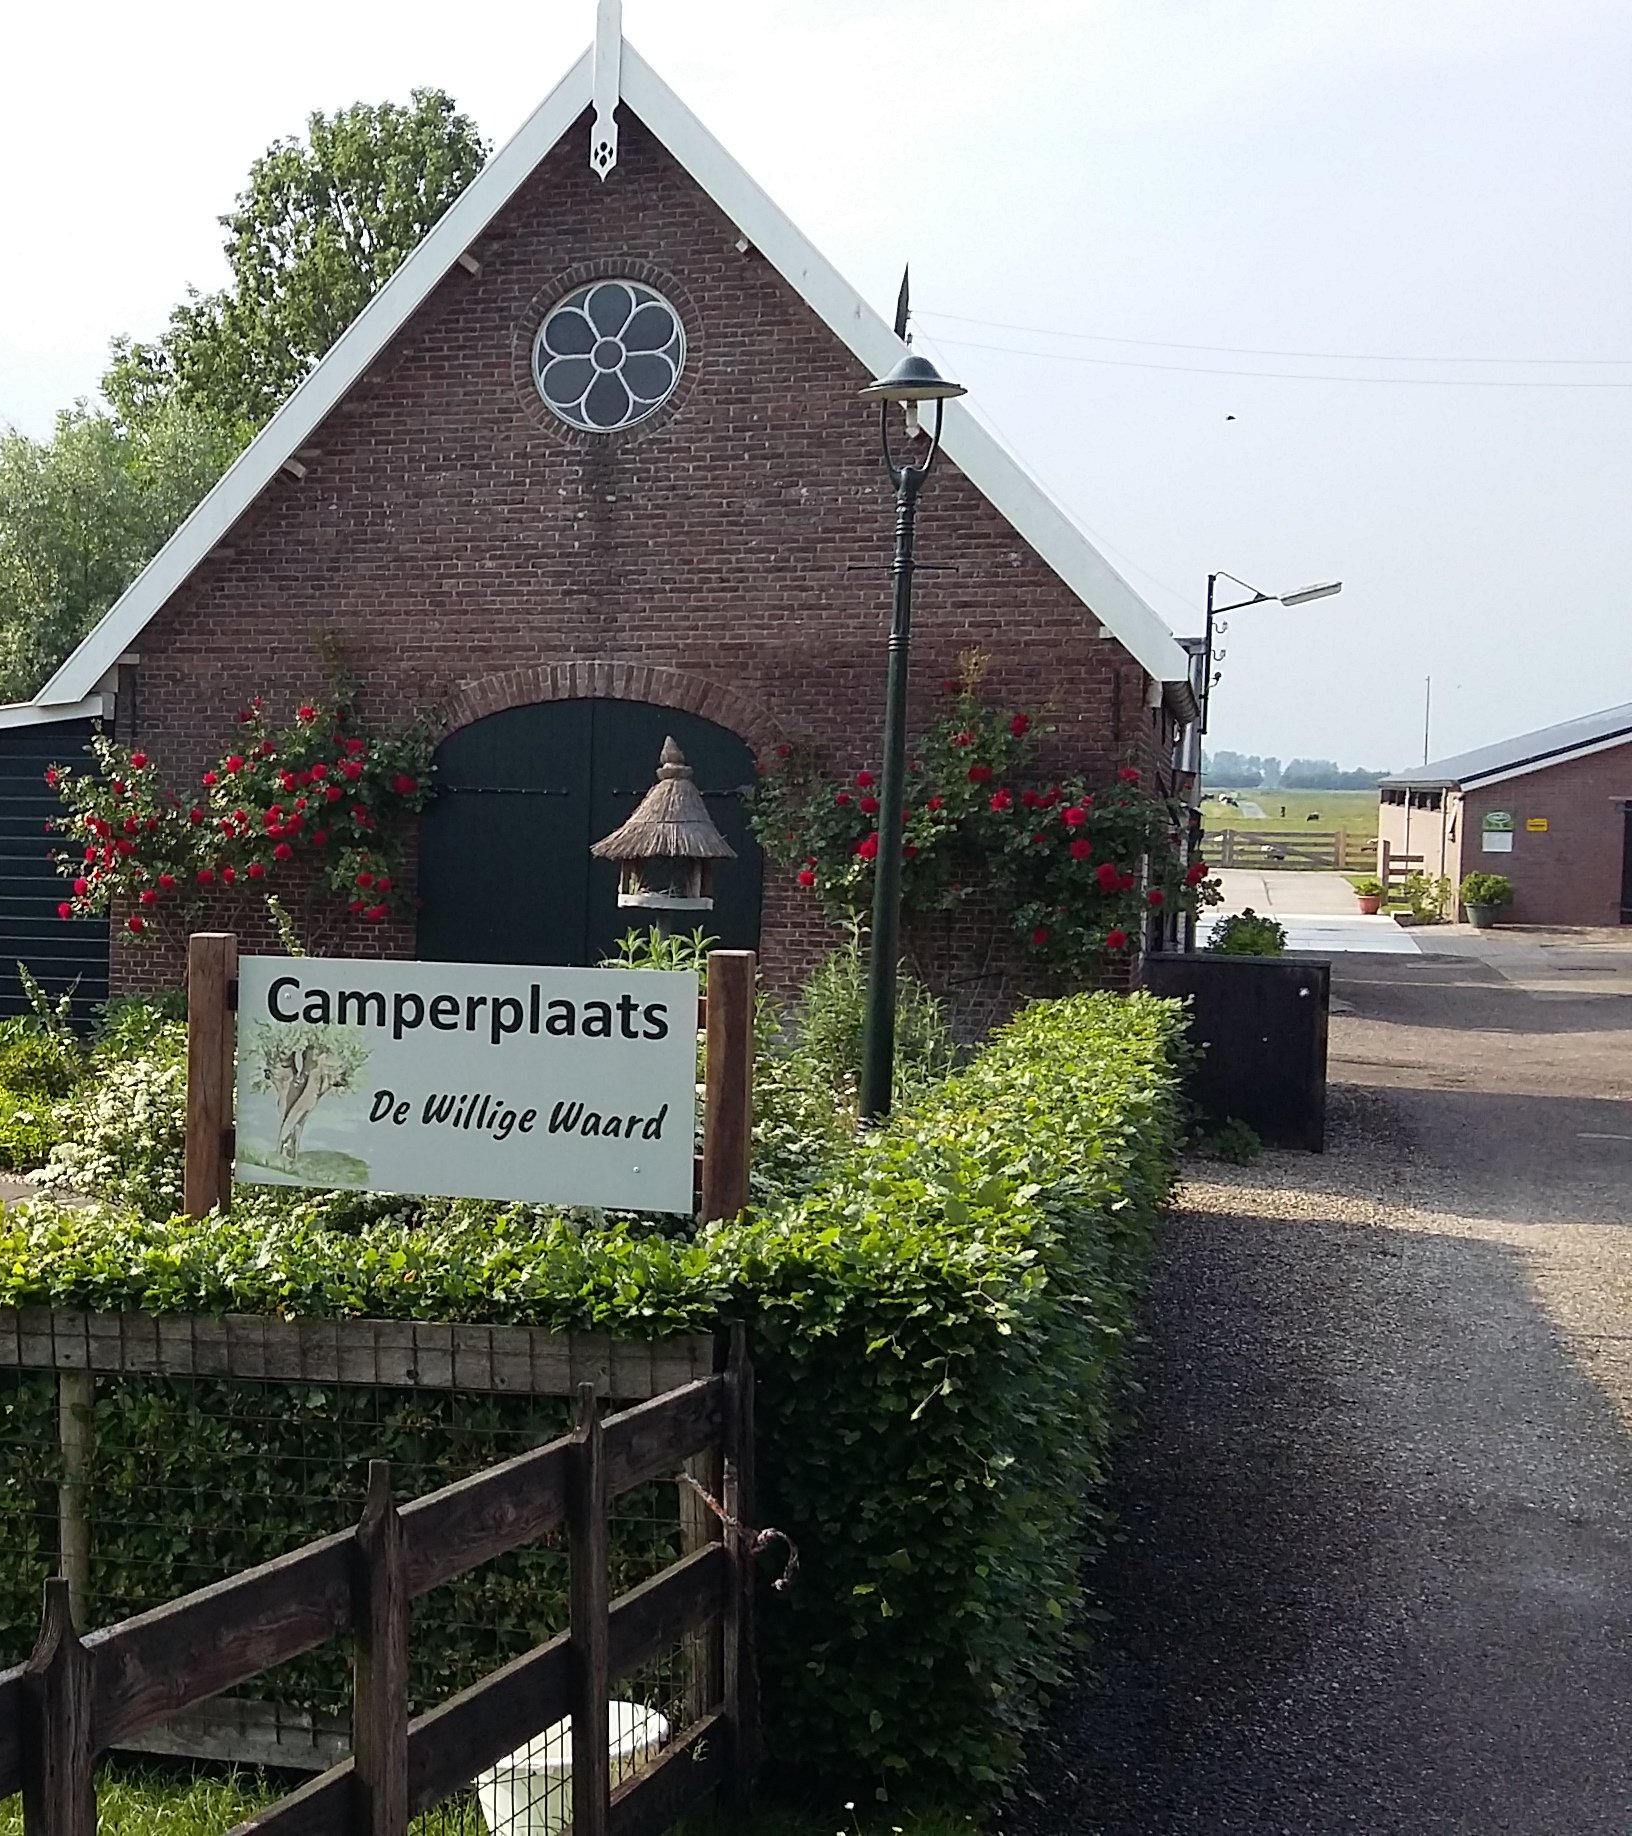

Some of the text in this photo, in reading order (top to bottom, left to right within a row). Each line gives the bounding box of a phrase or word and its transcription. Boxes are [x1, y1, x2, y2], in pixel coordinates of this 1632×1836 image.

[267, 976, 669, 1044] Camperplaats
[369, 1089, 669, 1140] De Willige Waard
